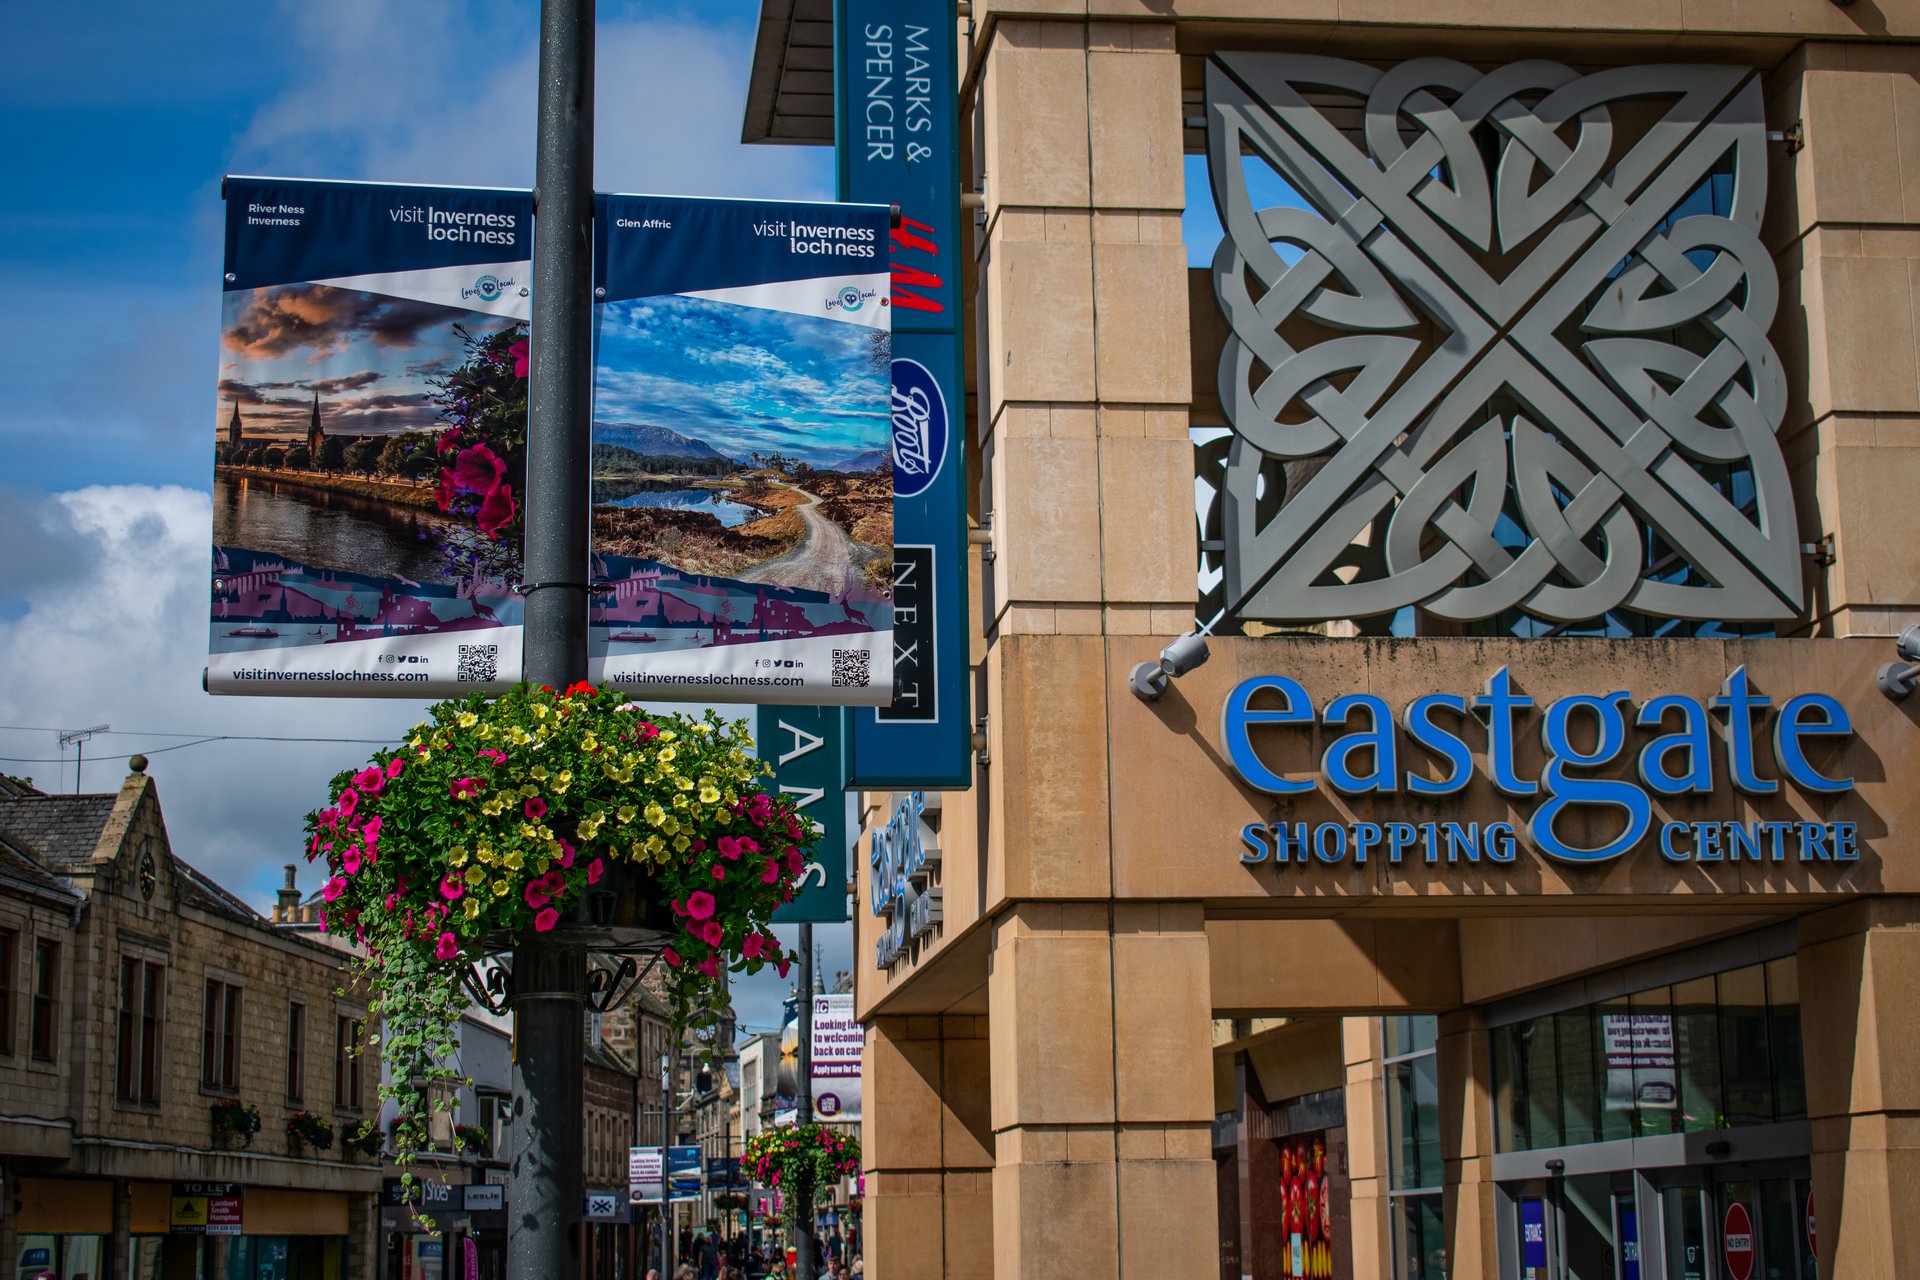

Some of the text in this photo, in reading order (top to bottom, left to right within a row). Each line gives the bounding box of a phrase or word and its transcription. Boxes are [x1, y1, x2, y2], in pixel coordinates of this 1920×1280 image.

[865, 23, 894, 162] SPENCER
[904, 24, 932, 163] MARKS &
[248, 204, 305, 215] River Ness
[389, 205, 516, 228] visit Inverness
[247, 215, 301, 226] Inverness
[616, 218, 672, 230] Glen Affric
[753, 220, 875, 241] visit Inverness
[427, 224, 515, 245] loch ness
[790, 237, 875, 258] loch ness
[889, 201, 944, 313] HM
[461, 287, 481, 300] Loves
[496, 277, 515, 291] Local
[825, 298, 843, 310] Loves
[858, 289, 877, 301] Local
[892, 383, 931, 475] Boots
[893, 560, 919, 708] NEXT
[232, 668, 429, 682] visitinvernesslochness.com
[613, 672, 804, 686] visitinvernesslochness.com
[1221, 663, 1855, 865] eastgate
[1238, 820, 1861, 864] SHOPPING CENTRE
[814, 1019, 847, 1031] Looking
[814, 1032, 863, 1043] to welcomin
[814, 1045, 863, 1056] back on cam
[813, 1065, 830, 1075] Apply
[184, 1183, 233, 1192] TO LET
[210, 1214, 240, 1222] Hampton
[1727, 1238, 1749, 1248] NO ENTRY
